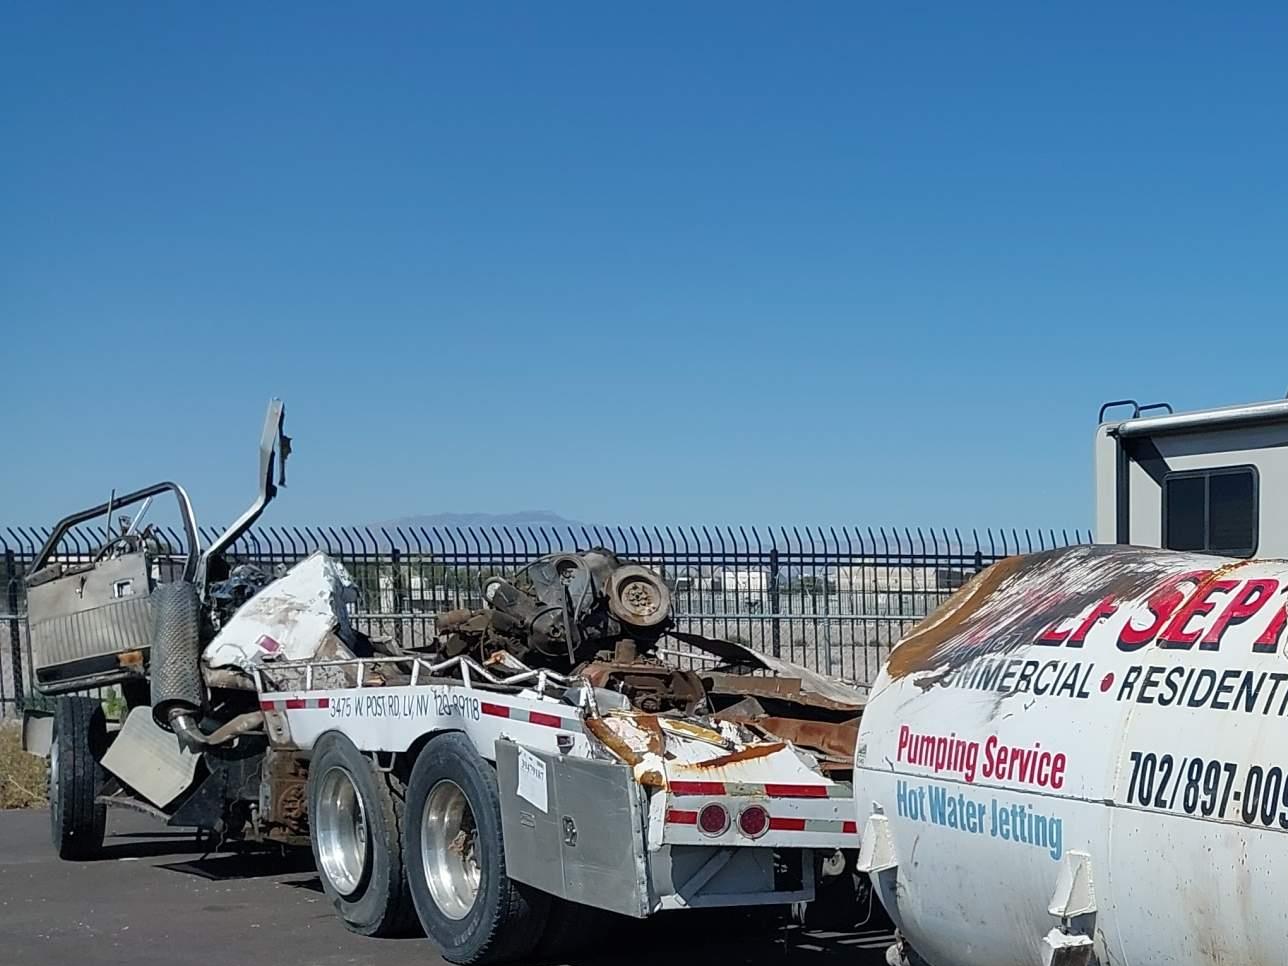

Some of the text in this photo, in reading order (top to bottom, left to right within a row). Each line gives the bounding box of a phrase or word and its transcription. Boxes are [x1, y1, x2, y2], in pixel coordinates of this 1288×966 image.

[330, 697, 351, 718] 3475
[367, 695, 386, 717] POST
[416, 694, 430, 717] NV
[897, 725, 979, 782] Pumping
[982, 735, 1066, 789] Service
[897, 780, 1063, 861] Hot Water Jetting
